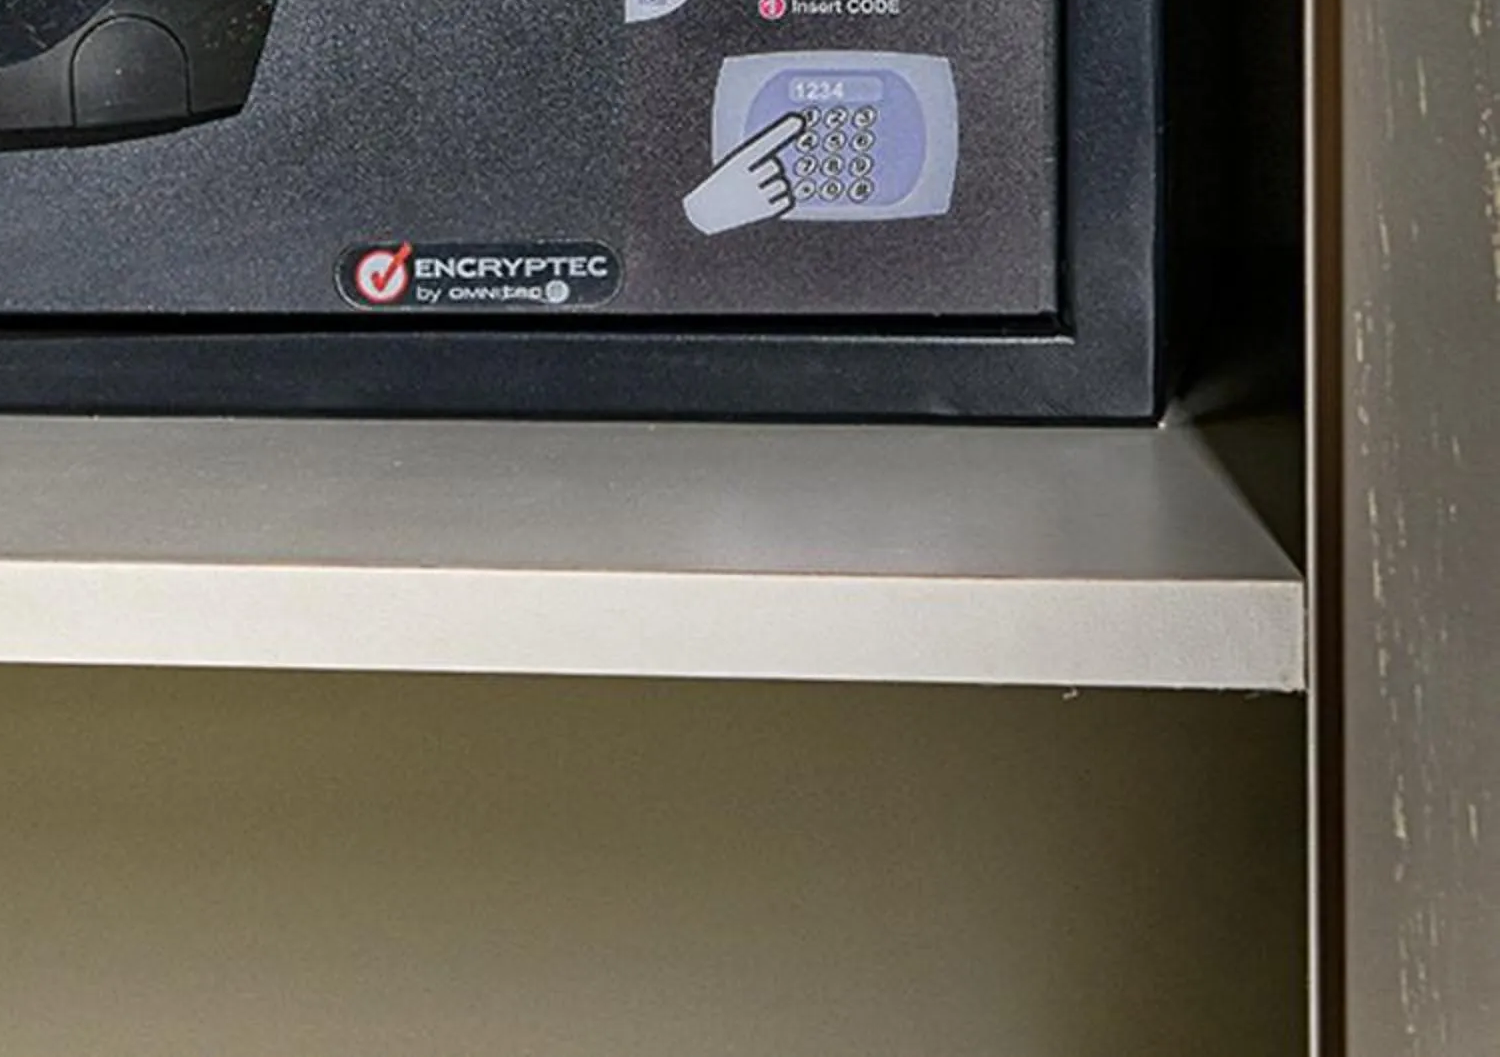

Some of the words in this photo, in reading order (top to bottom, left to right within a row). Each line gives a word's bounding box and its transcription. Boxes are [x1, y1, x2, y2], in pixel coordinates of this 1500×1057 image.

[796, 82, 844, 99] 1234
[414, 256, 608, 278] ENCRYPTEC
[416, 286, 441, 304] by
